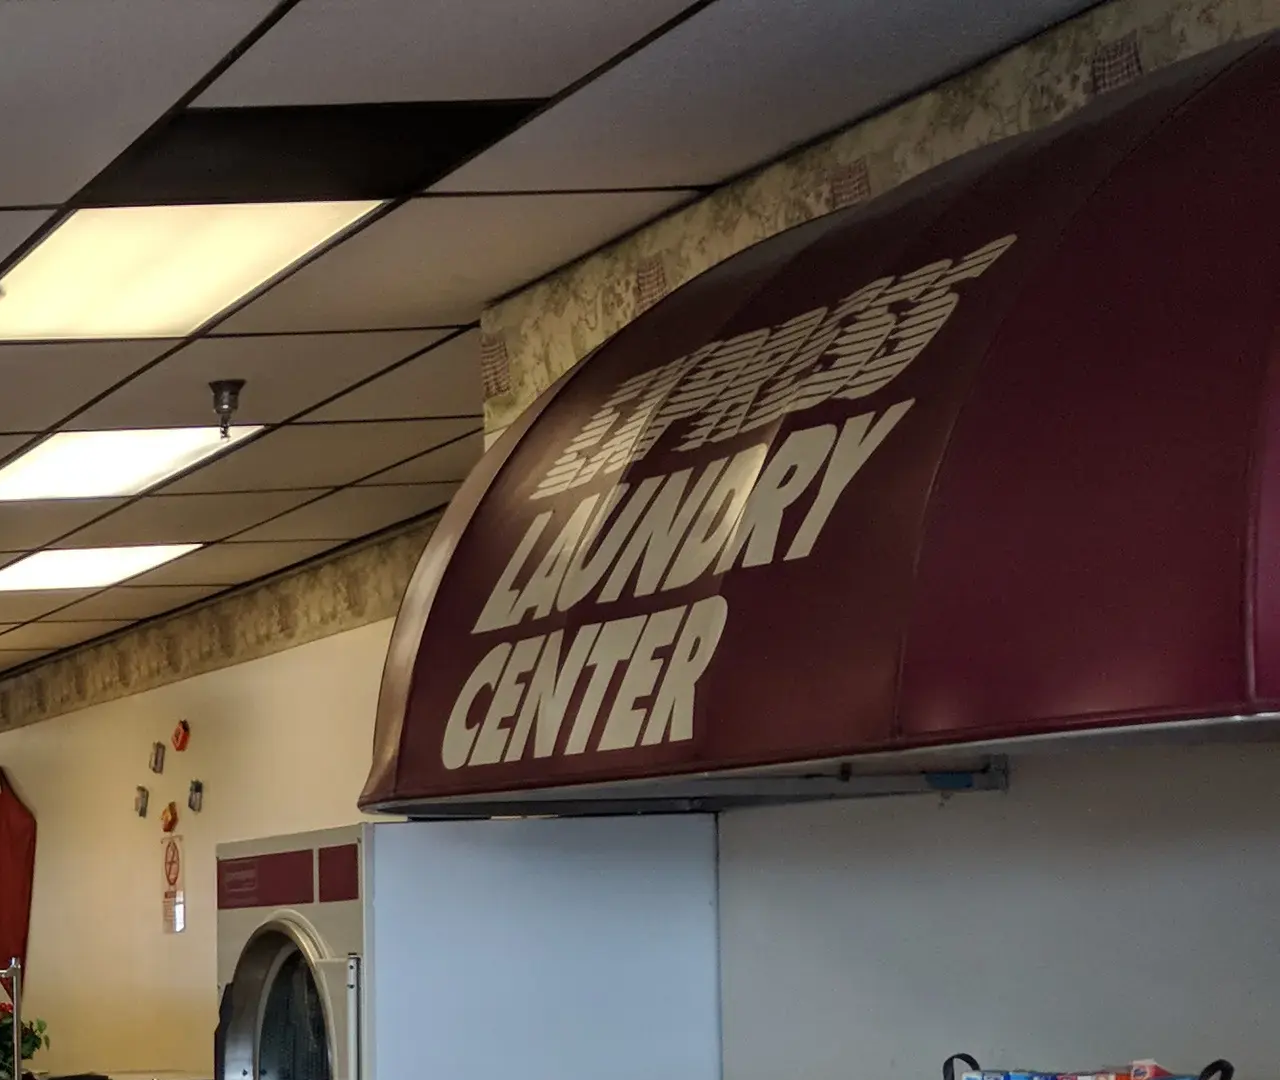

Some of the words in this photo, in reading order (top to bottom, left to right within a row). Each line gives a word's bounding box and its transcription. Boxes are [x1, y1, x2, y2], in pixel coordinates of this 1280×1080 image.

[530, 234, 1017, 500] EXPRESS
[472, 398, 915, 634] LAUNDRY
[441, 594, 728, 770] CENTER
